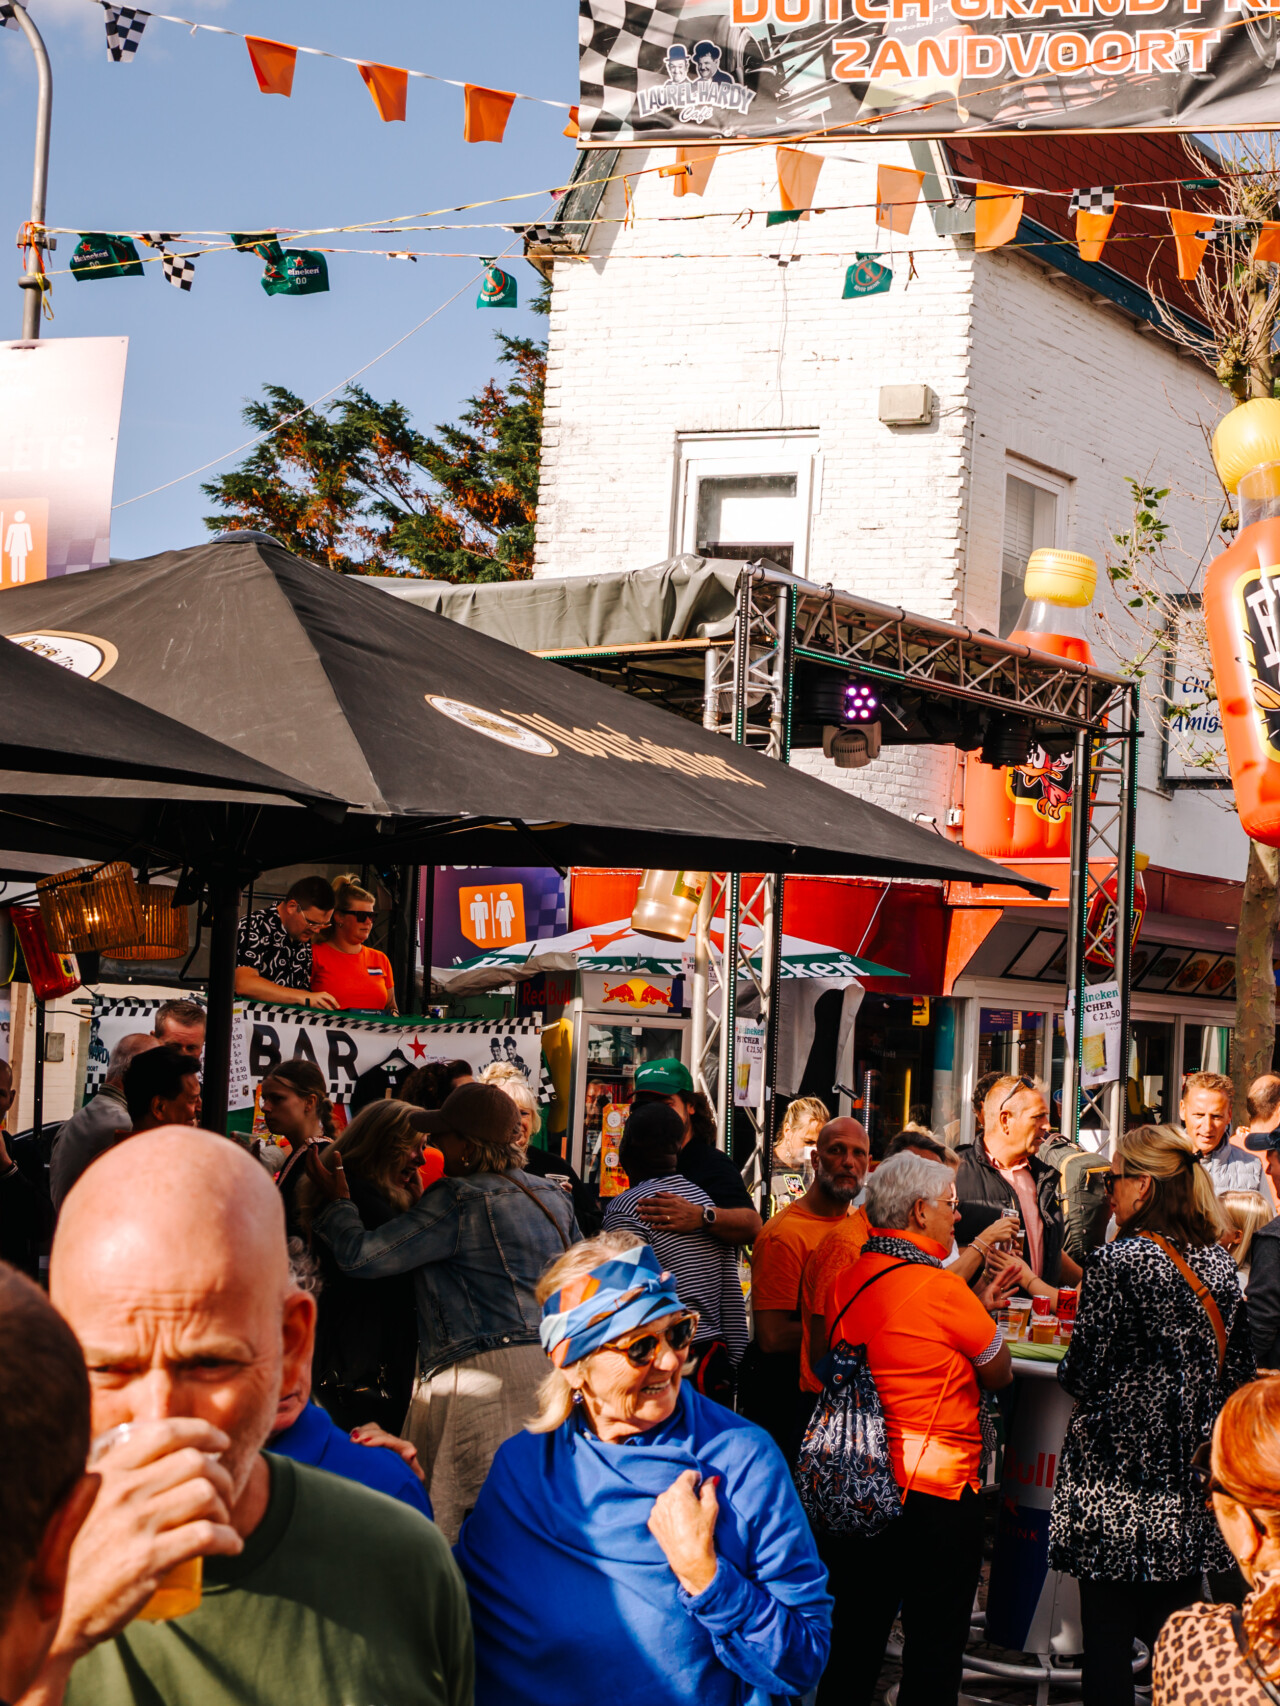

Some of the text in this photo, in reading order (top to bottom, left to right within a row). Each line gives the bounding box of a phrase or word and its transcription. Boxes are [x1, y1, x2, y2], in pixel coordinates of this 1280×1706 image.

[833, 30, 1220, 81] ZANDVOORT
[287, 267, 320, 276] eineken
[1172, 712, 1222, 734] Amig
[248, 1023, 359, 1081] BAR
